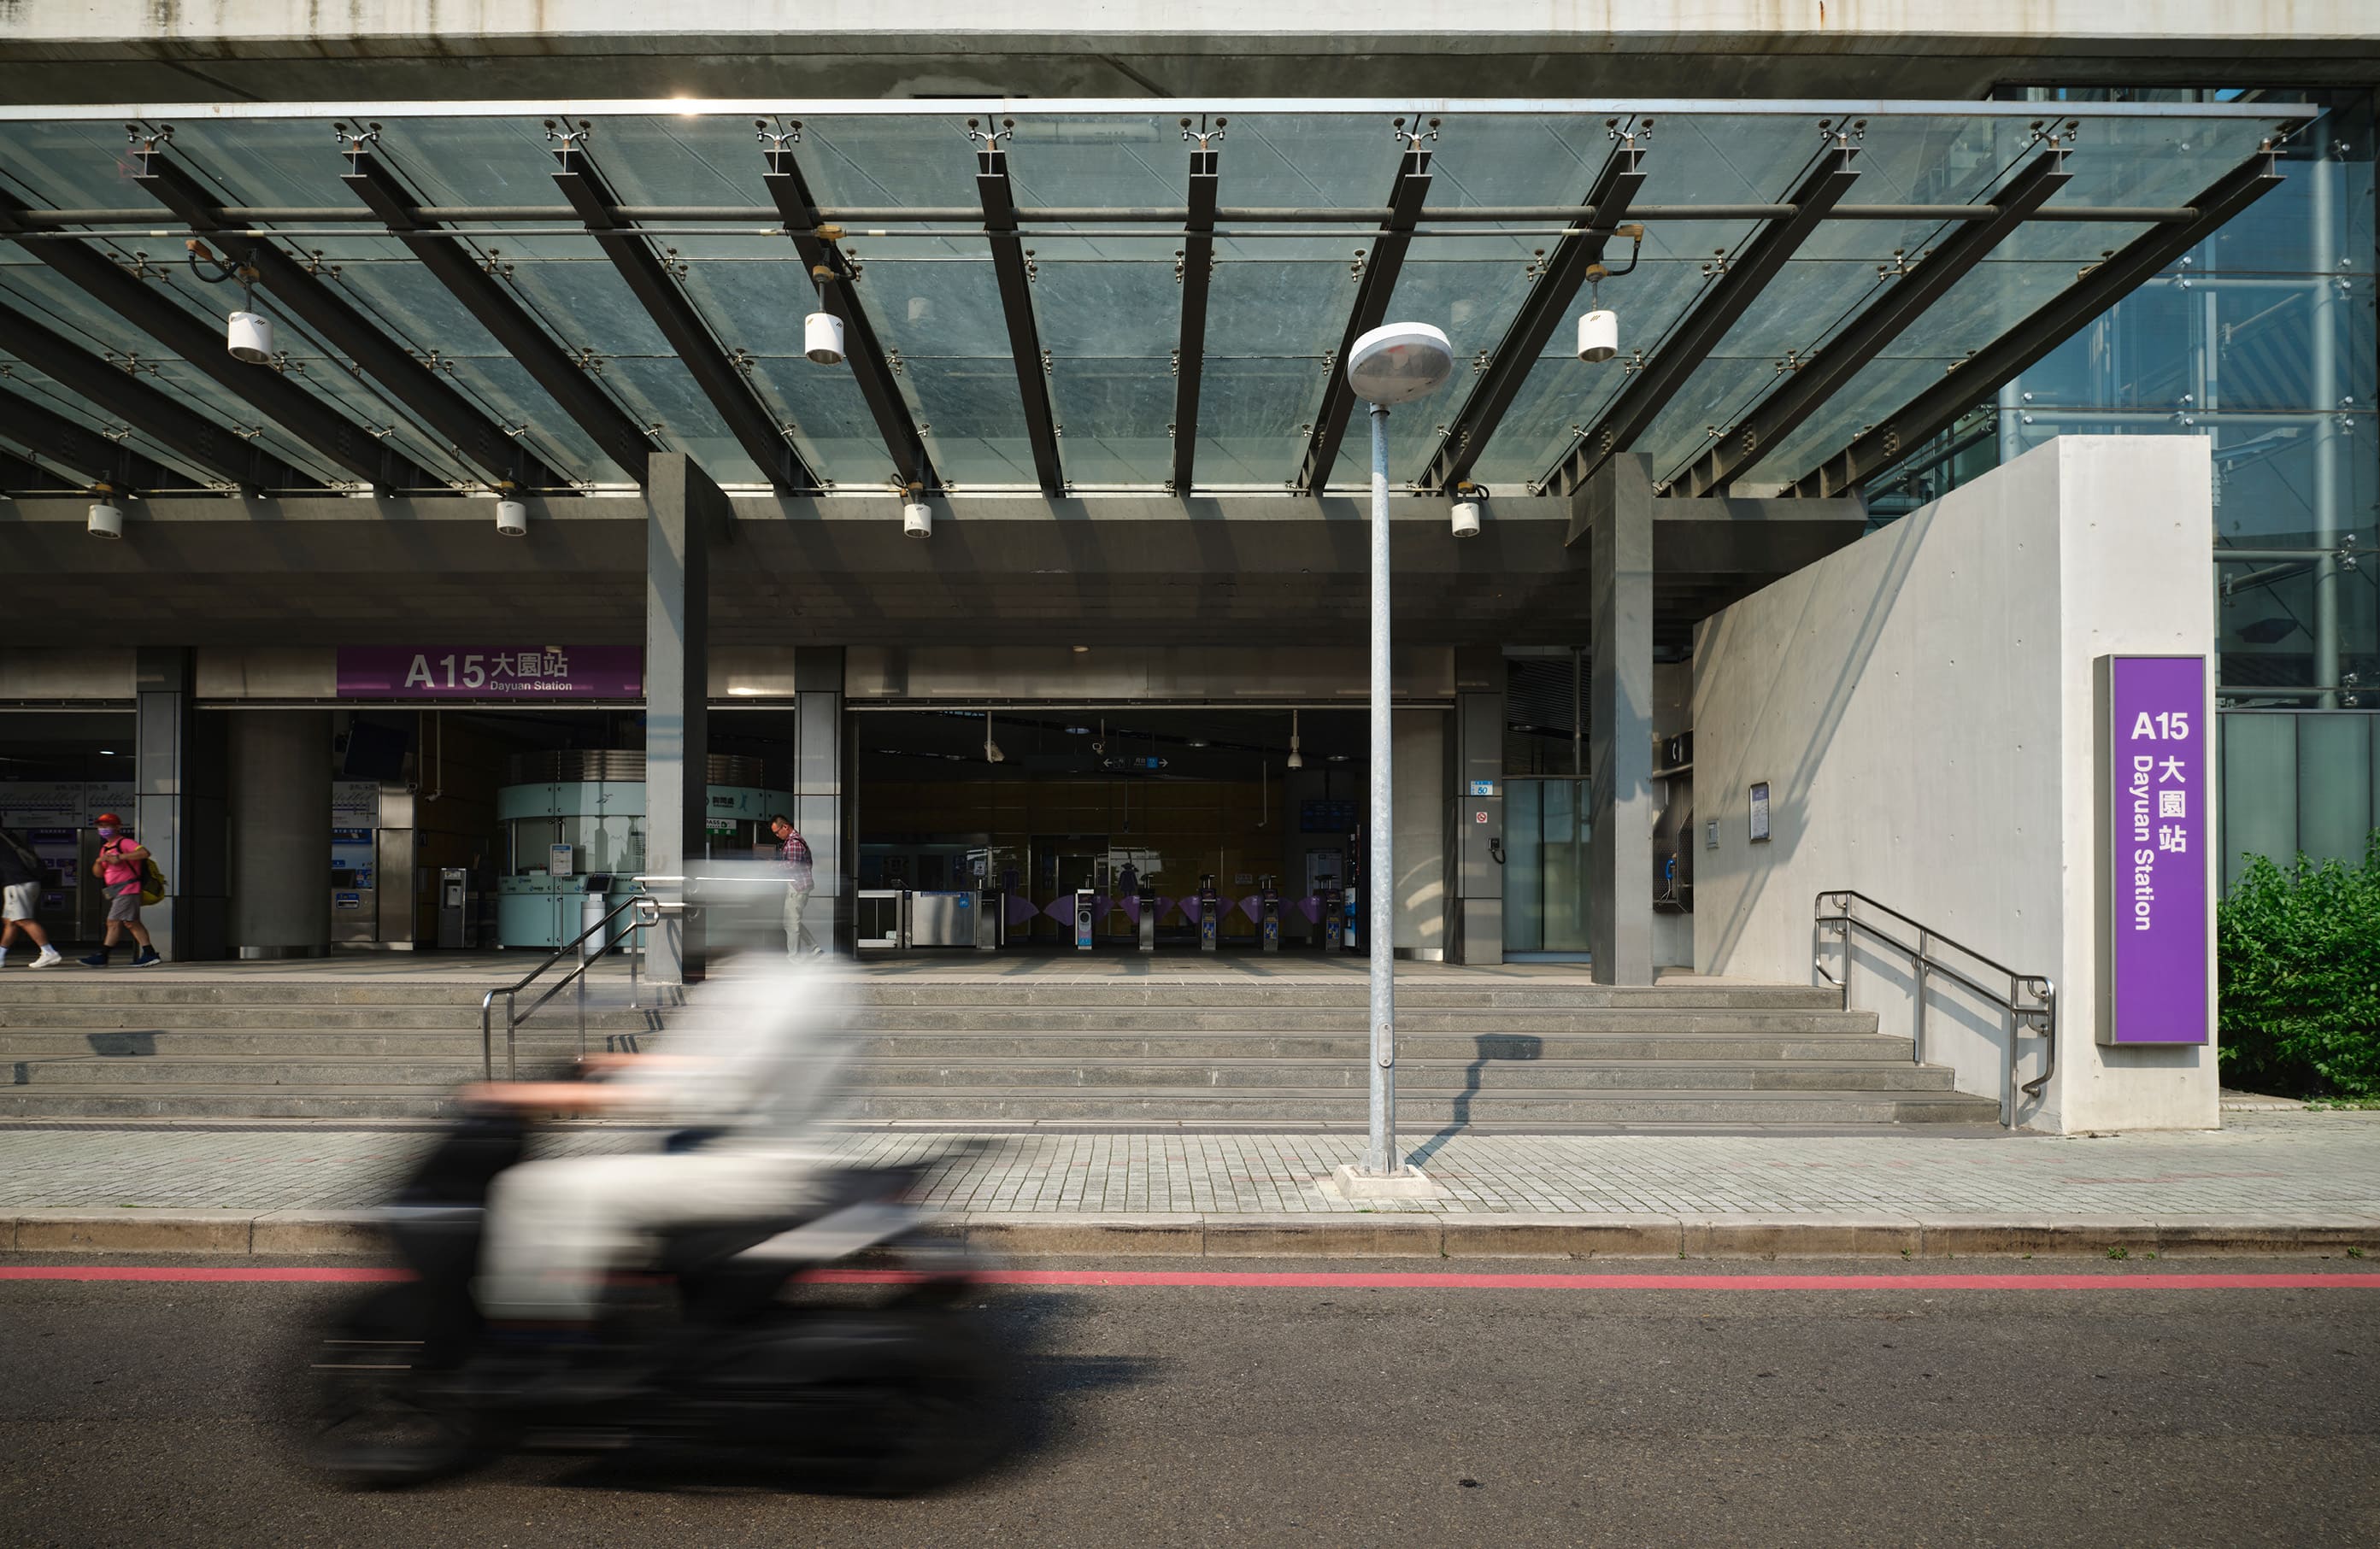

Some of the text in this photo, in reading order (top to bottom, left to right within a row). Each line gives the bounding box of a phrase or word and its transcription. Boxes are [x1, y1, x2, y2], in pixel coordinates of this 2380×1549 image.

[404, 654, 485, 688] A15
[491, 652, 568, 678] 大園站
[491, 681, 573, 691] Dayuan Station
[2130, 712, 2189, 740] A15
[2159, 755, 2187, 853] 大園站
[2129, 755, 2154, 930] Dayuan Station
